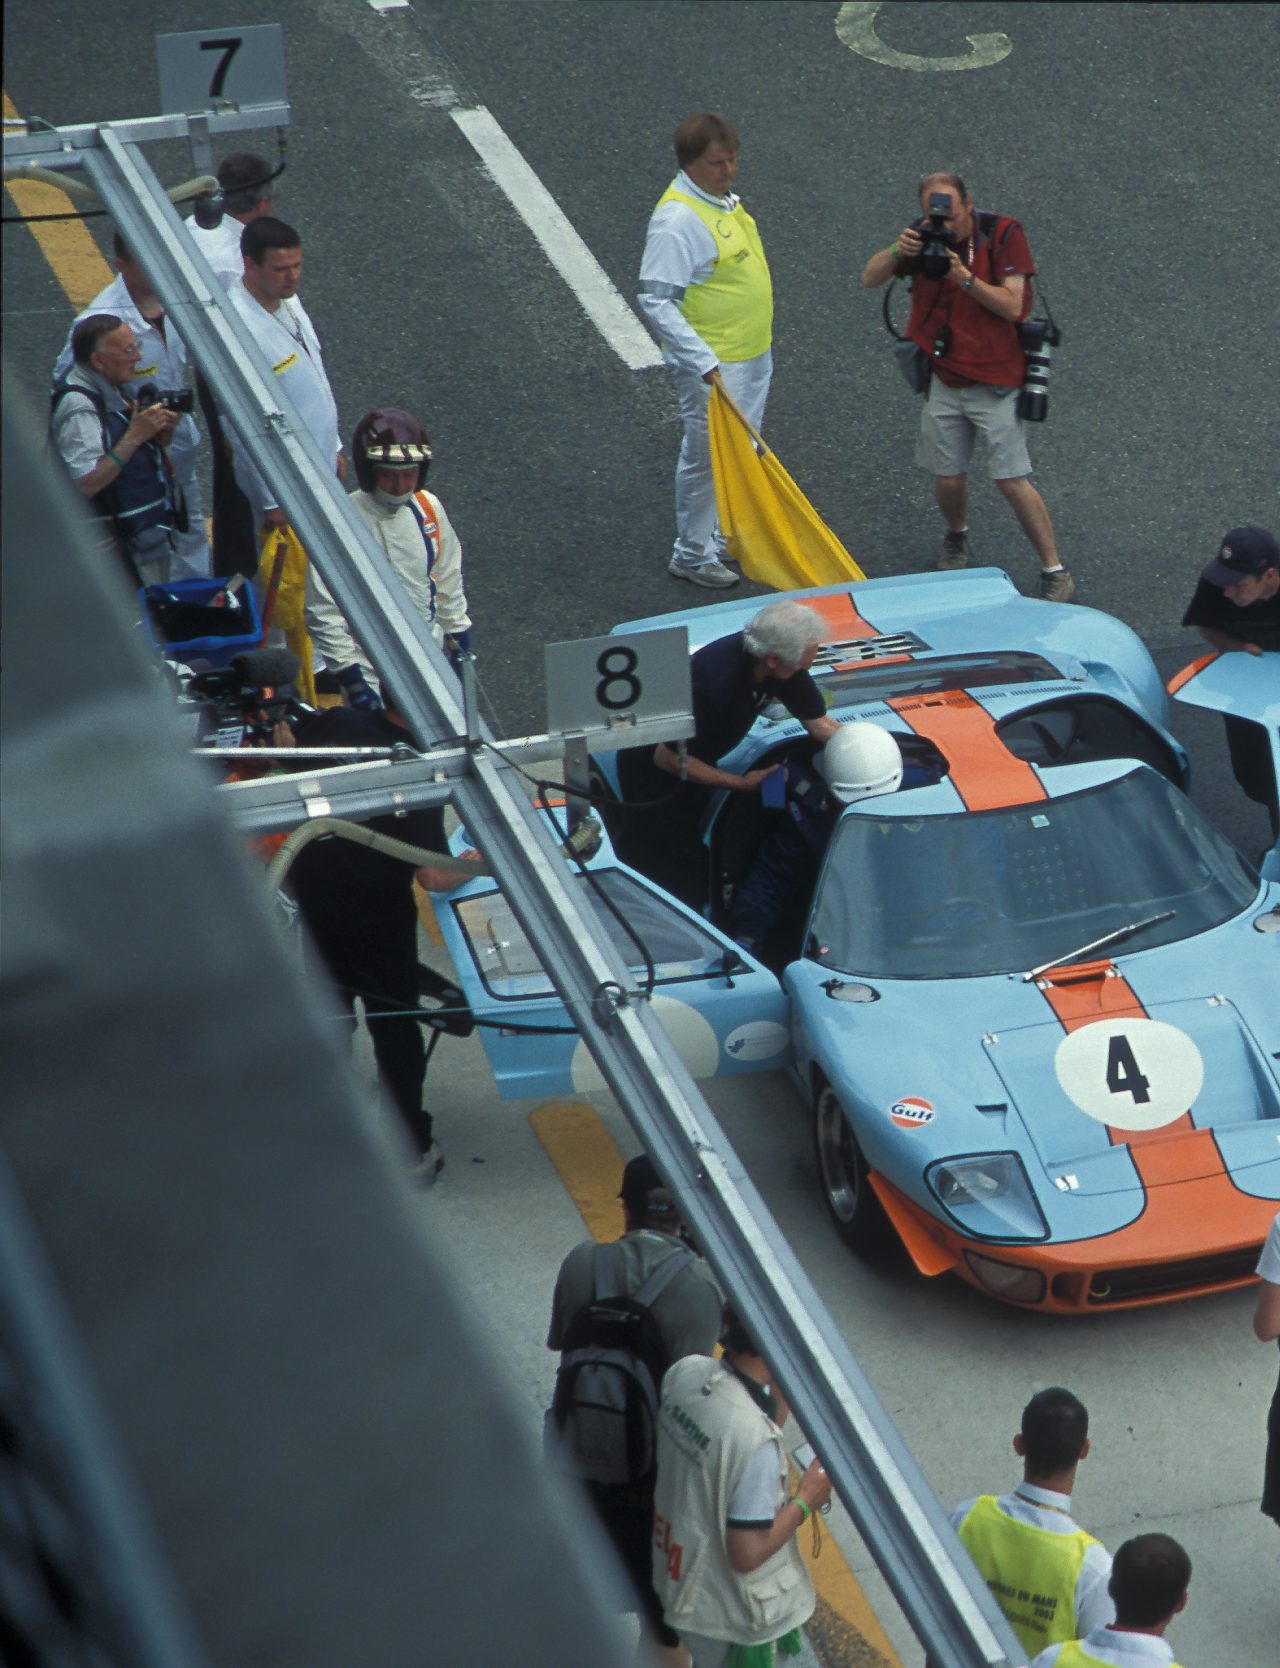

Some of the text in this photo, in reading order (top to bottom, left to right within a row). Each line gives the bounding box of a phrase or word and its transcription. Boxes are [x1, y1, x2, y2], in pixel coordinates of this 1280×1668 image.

[199, 37, 243, 98] 7
[596, 645, 642, 710] 8
[1106, 1034, 1151, 1104] 4
[891, 1103, 934, 1121] Gulf
